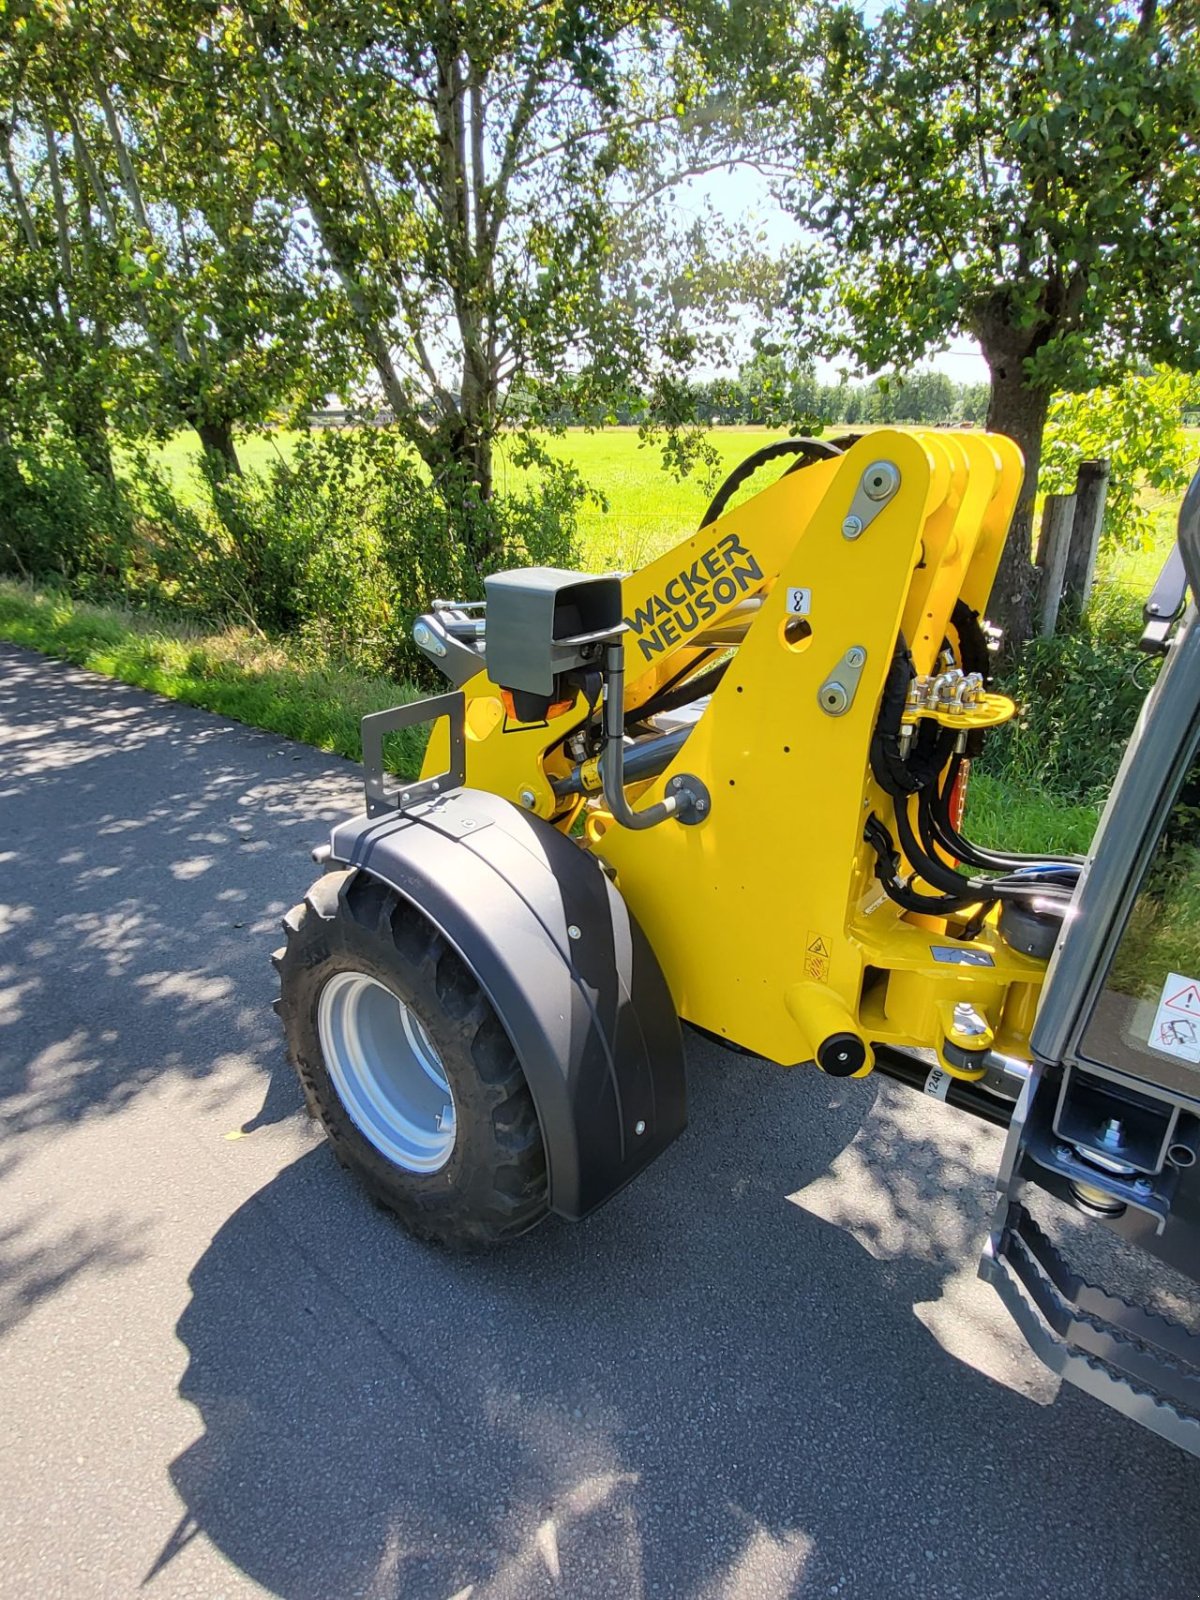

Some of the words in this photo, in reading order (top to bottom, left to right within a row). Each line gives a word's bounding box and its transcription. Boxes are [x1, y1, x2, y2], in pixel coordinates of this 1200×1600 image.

[623, 534, 750, 634] WACKER
[637, 555, 764, 662] NEUSON
[927, 1070, 944, 1095] 1240
